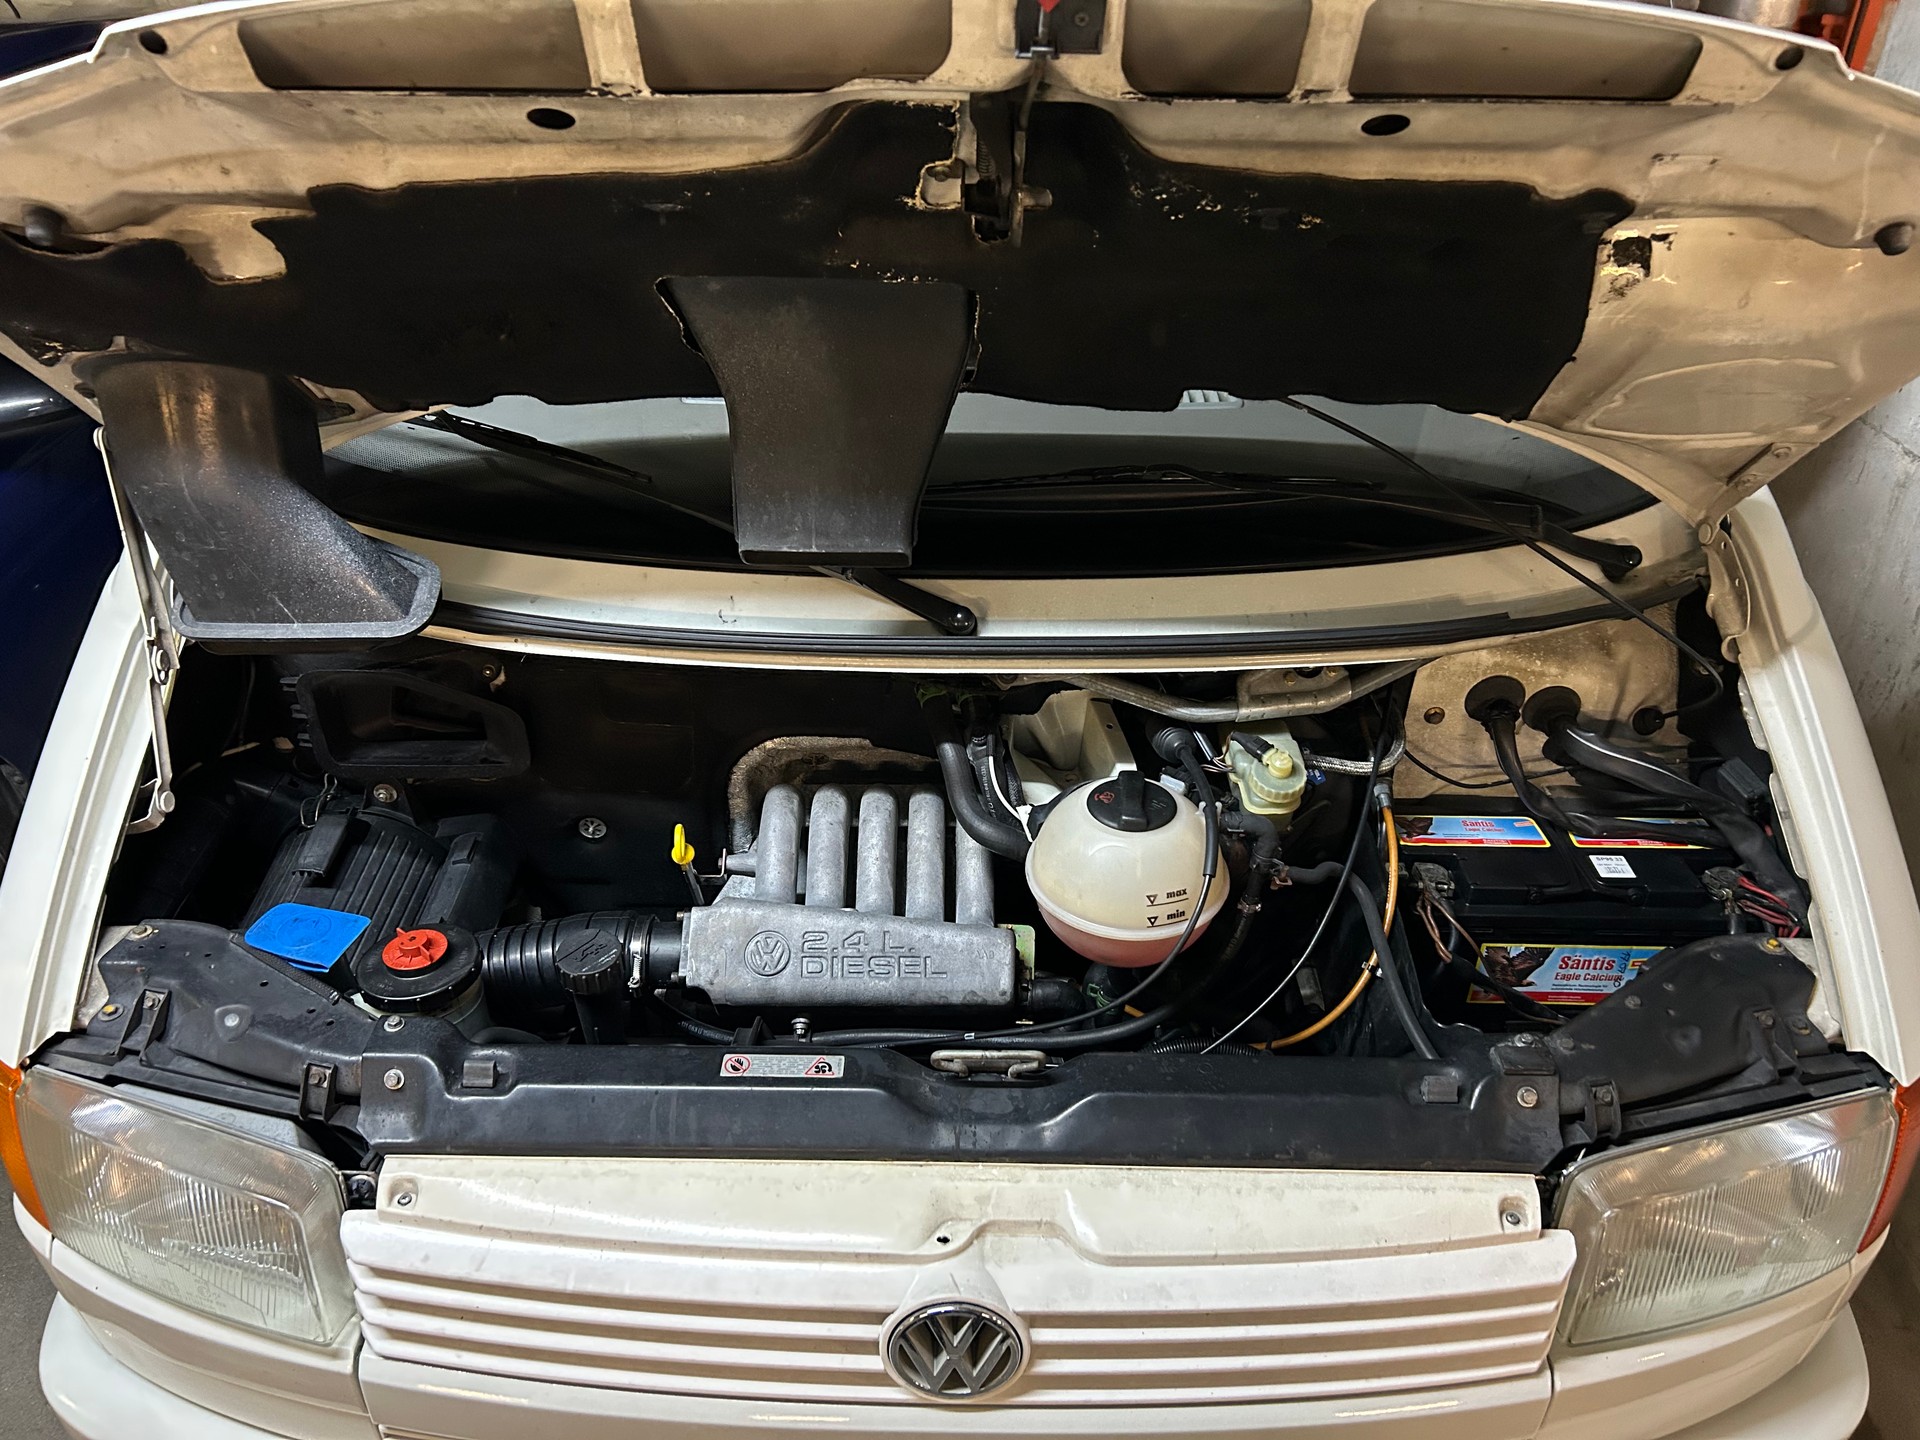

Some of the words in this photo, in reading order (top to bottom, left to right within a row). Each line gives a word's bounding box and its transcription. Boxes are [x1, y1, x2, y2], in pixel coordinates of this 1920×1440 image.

[1166, 888, 1188, 899] max
[1166, 909, 1186, 920] min
[801, 930, 869, 953] 2.4
[801, 955, 948, 979] DIESEL
[1558, 954, 1616, 971] Säntis
[1554, 972, 1582, 982] Eagle
[1583, 972, 1623, 982] Calcium
[888, 1301, 1022, 1399] VW
